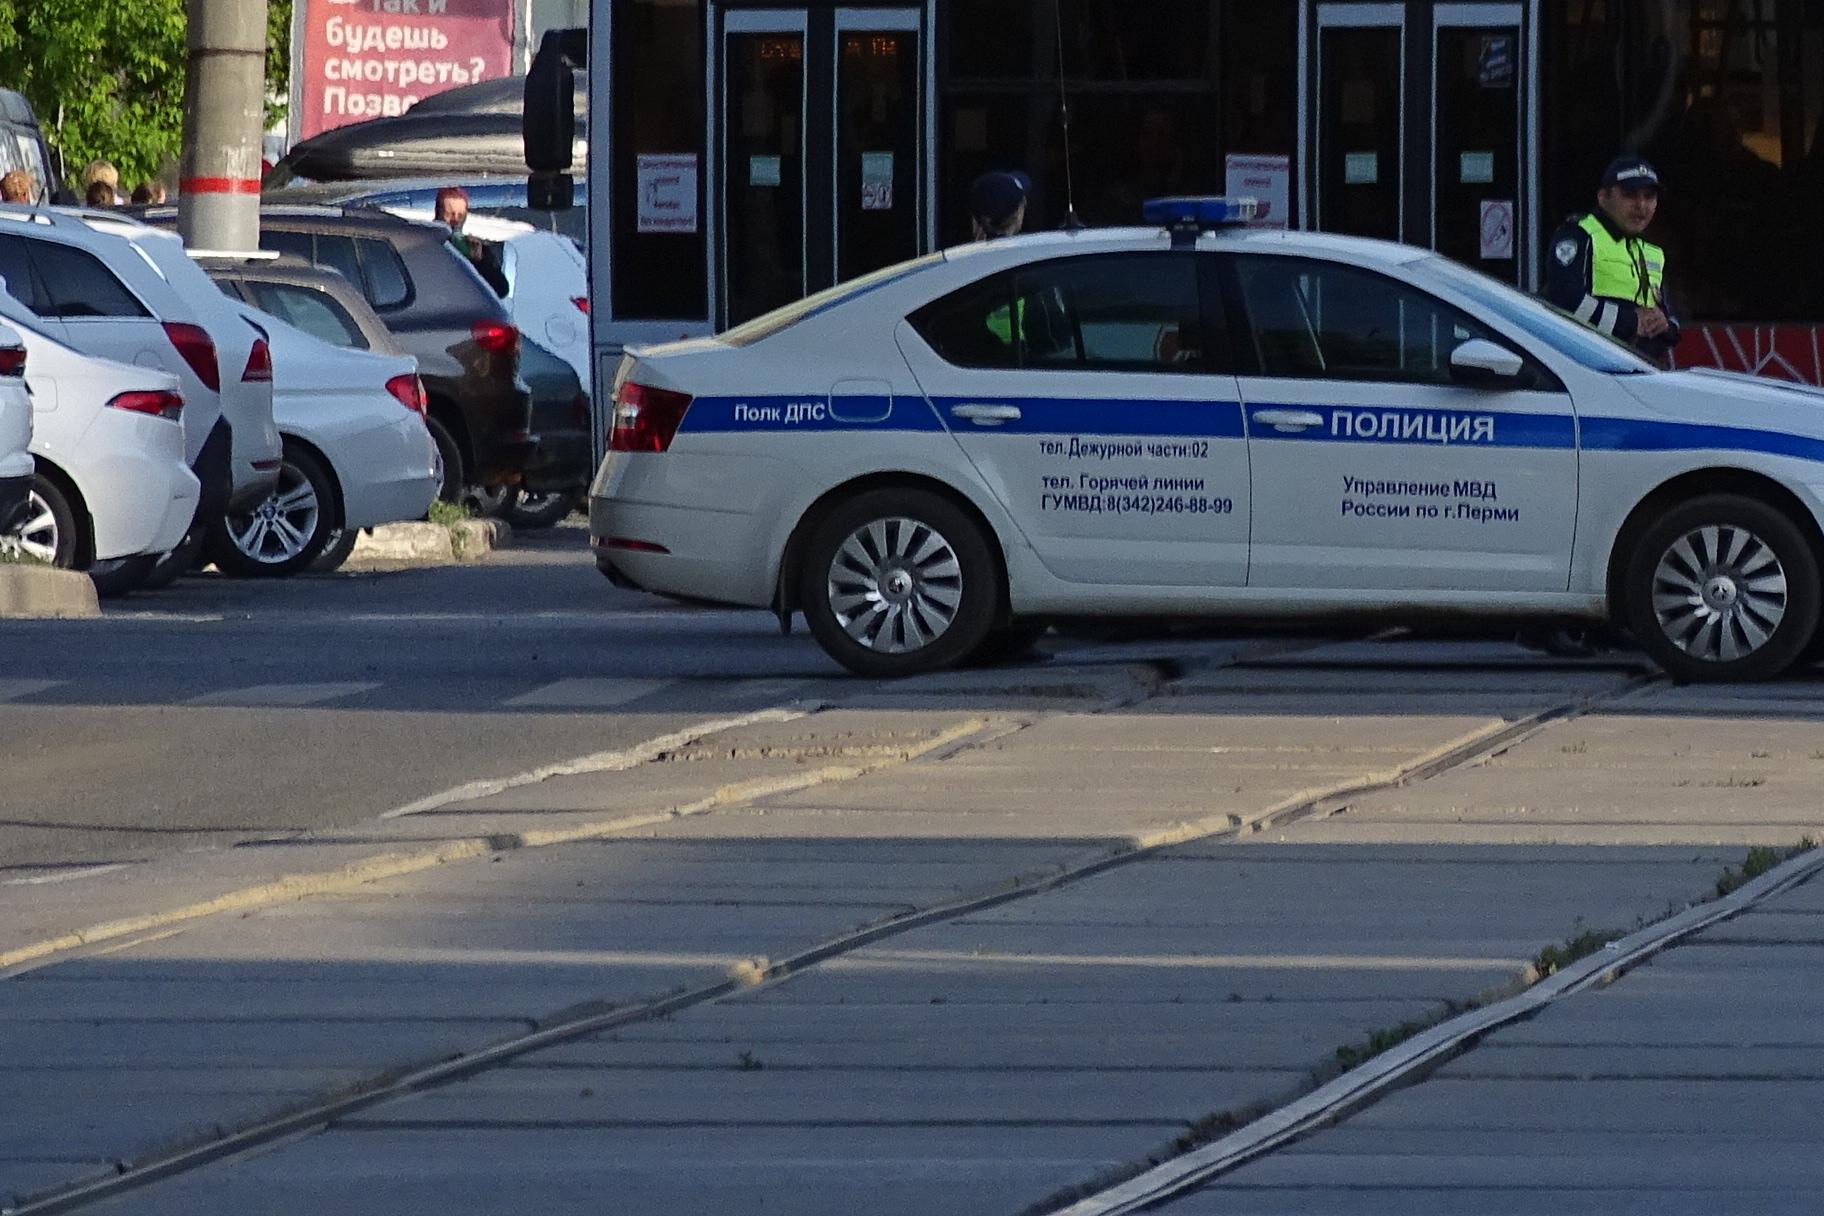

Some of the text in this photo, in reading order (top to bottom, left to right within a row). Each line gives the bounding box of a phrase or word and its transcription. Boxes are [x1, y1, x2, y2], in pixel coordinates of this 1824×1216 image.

[326, 16, 449, 54] будешь
[324, 56, 486, 87] смотреть?
[734, 402, 826, 425] Полк ДПС
[1331, 410, 1495, 444] ПОЛИЦИЯ
[1041, 472, 1205, 494] тел. Горячей линии
[1343, 475, 1497, 502] Управление МВД
[1341, 500, 1520, 524] России по г.Перми
